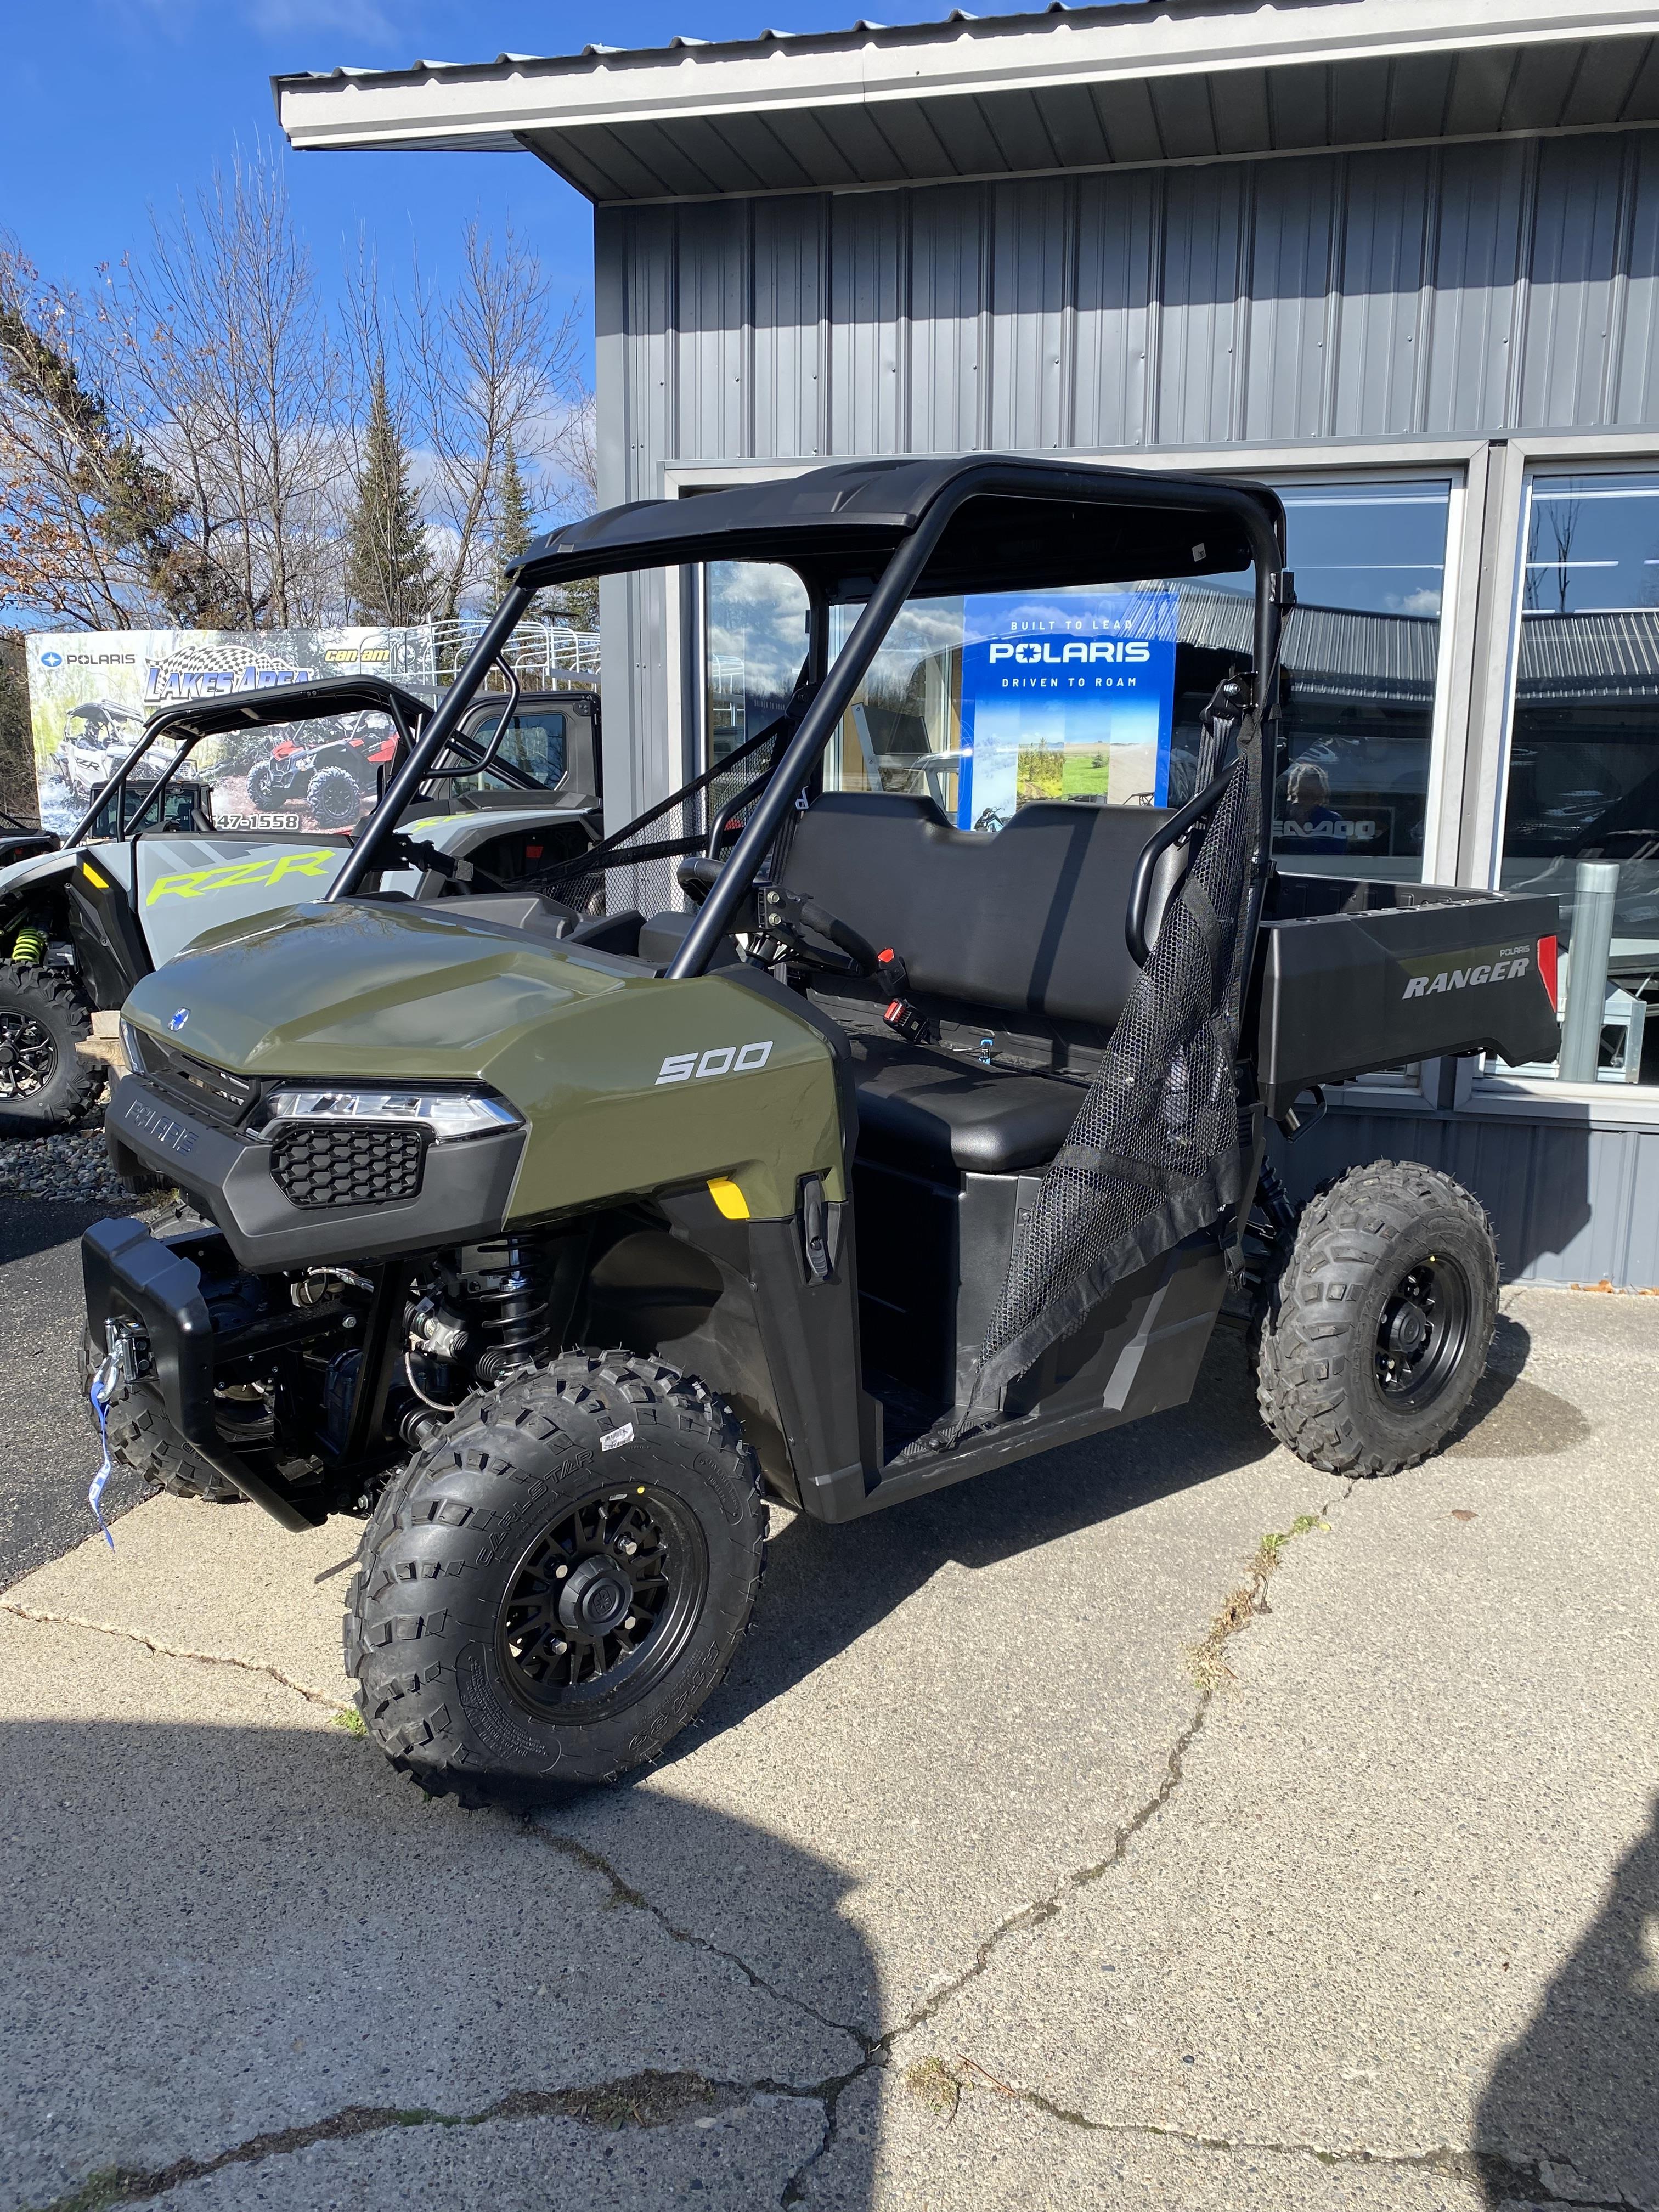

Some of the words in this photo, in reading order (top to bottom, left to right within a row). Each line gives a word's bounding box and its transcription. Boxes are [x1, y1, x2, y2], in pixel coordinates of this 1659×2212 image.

[1011, 622, 1056, 630] BUILT
[1065, 621, 1082, 630] TO
[1092, 620, 1133, 630] LEAD
[66, 654, 136, 664] POLARIS
[989, 641, 1150, 663] POLARIS
[144, 667, 235, 703] LAKES
[1002, 678, 1058, 687] DRIVEN
[1068, 678, 1086, 687] TO
[1095, 678, 1136, 686] ROAM
[145, 849, 337, 907] RZR
[1499, 945, 1530, 957] POLARIS
[1401, 957, 1530, 1000] RANGER
[654, 1040, 774, 1085] 500
[125, 1099, 200, 1156] POLARIS
[475, 1449, 594, 1567] CARLSTAR
[629, 1640, 719, 1750] AT489
